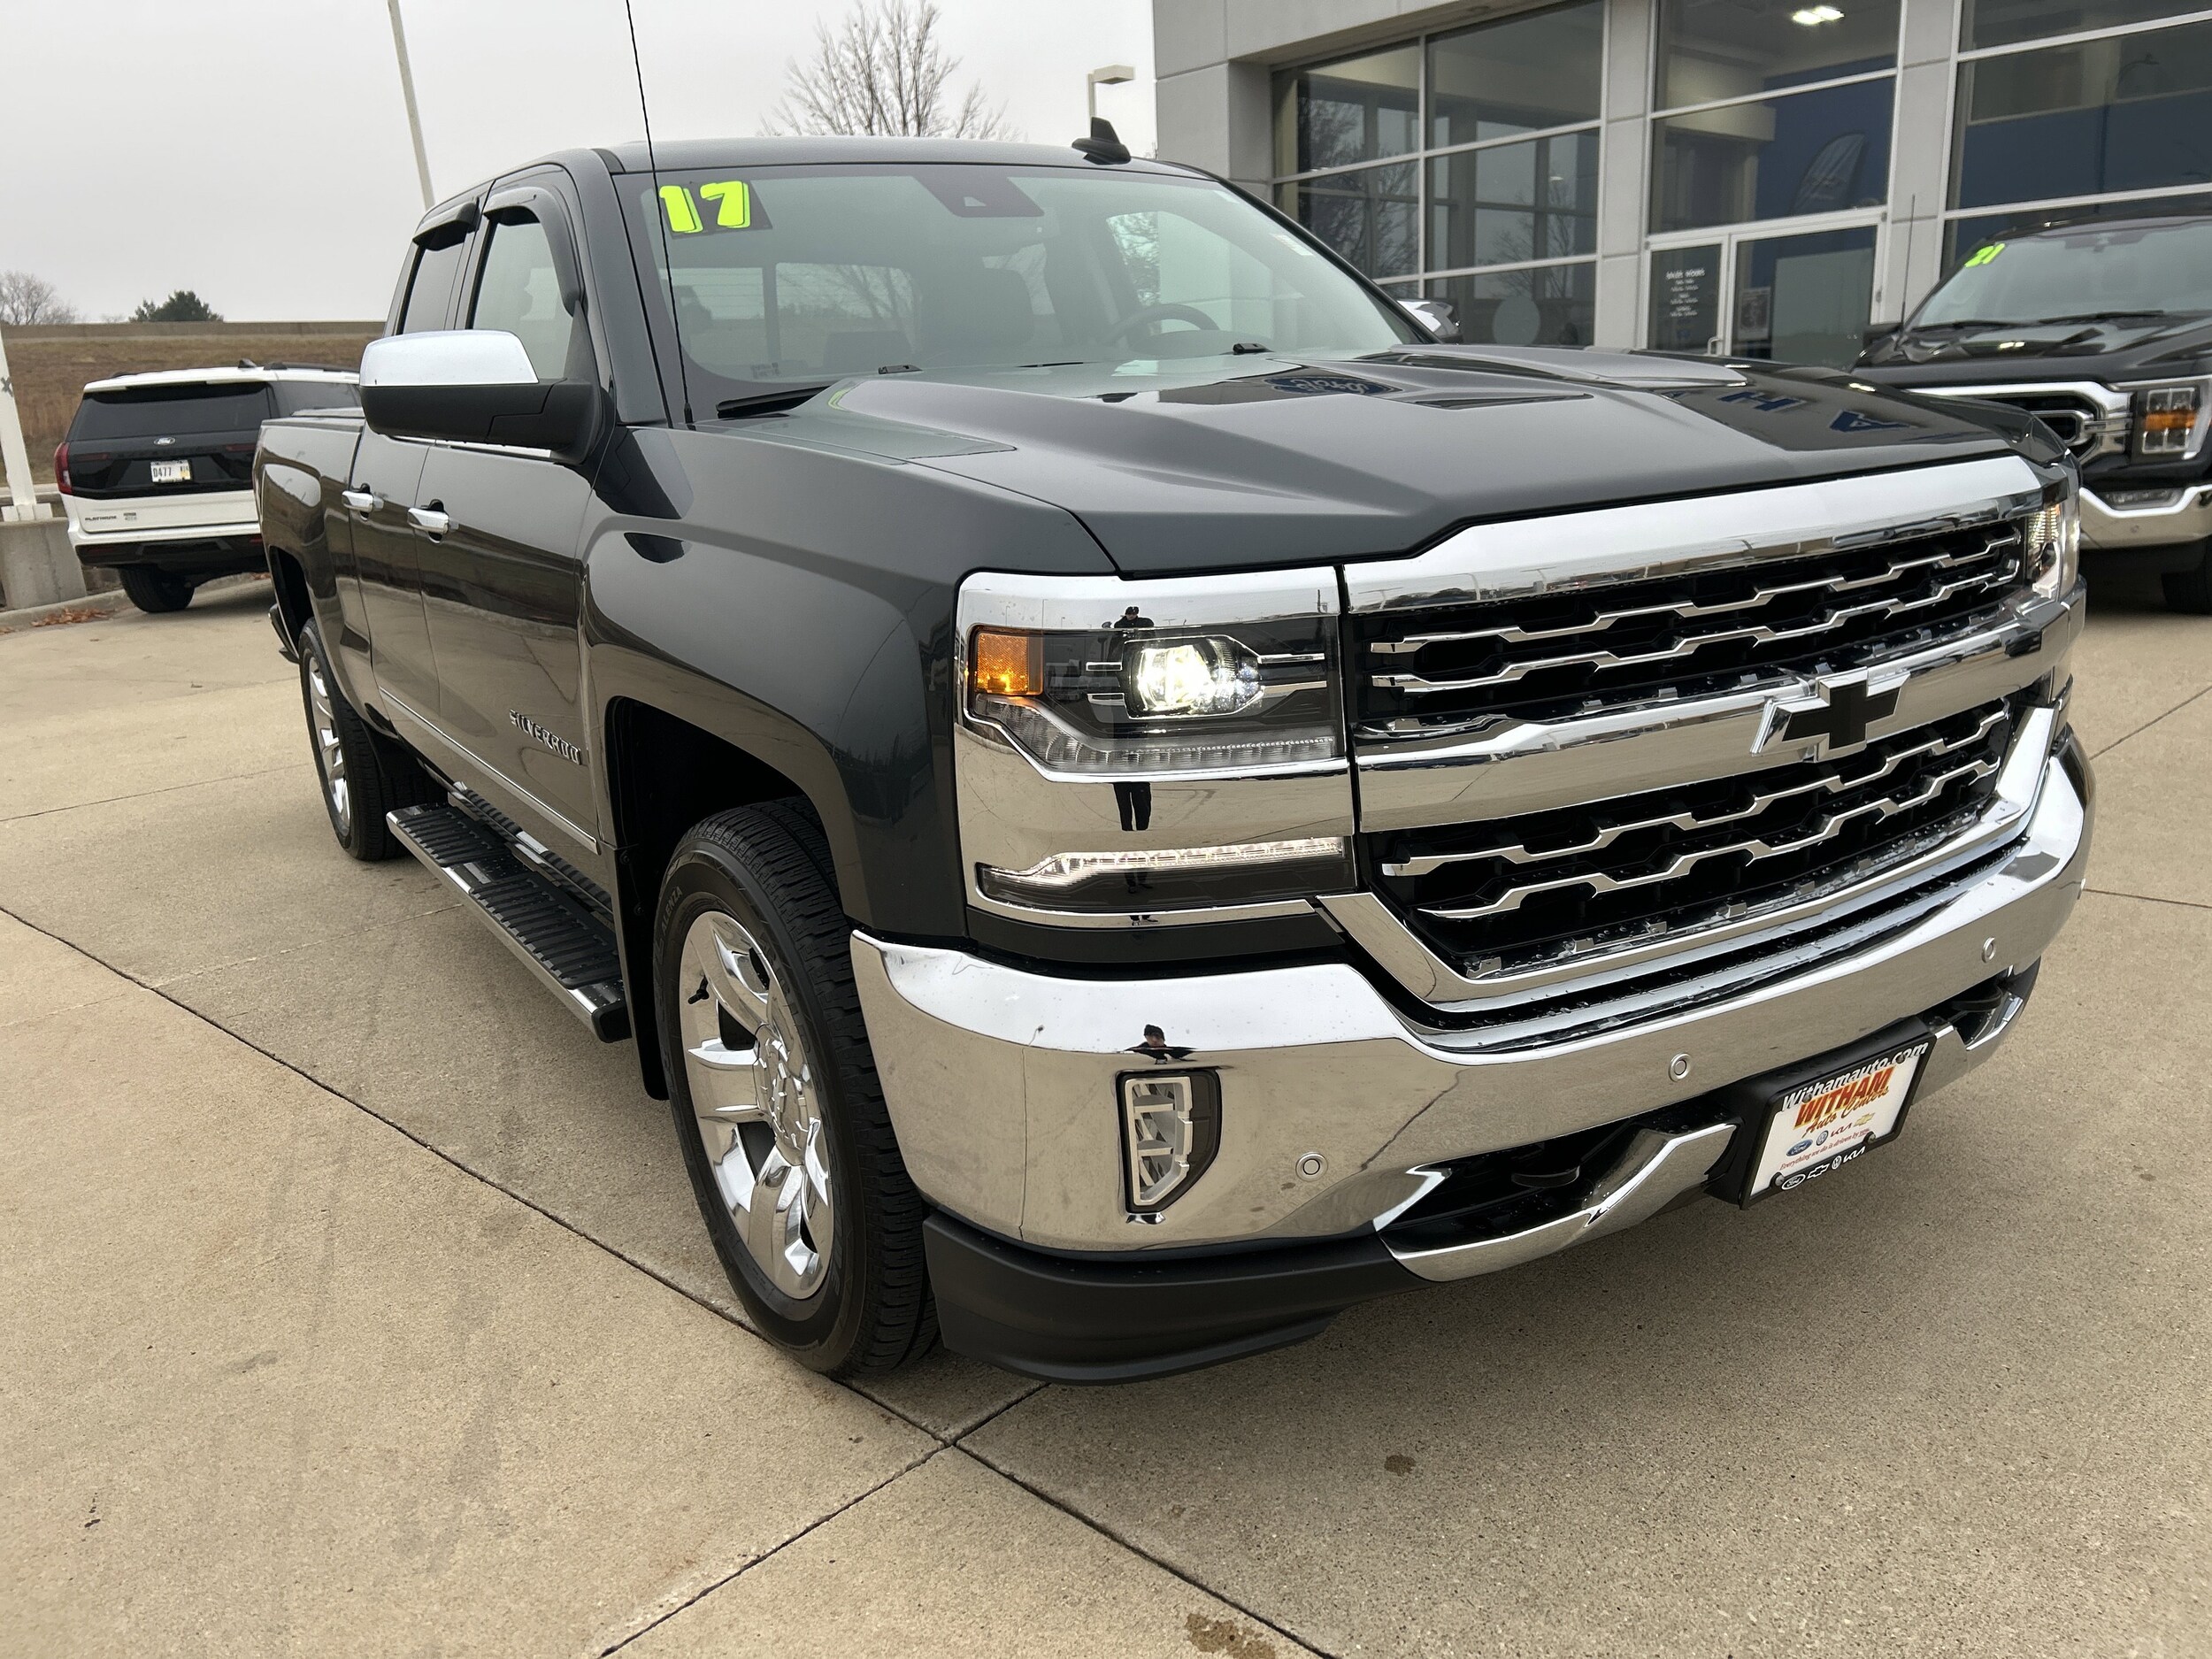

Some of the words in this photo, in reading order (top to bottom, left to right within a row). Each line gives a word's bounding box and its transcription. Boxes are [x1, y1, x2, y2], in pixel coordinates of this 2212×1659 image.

[659, 180, 751, 234] 17
[1963, 242, 2006, 268] 21
[509, 709, 582, 765] SILVERADO
[661, 886, 683, 937] ALENZA
[1794, 1065, 1895, 1129] WITHAM
[1801, 1112, 1838, 1139] Auto
[1840, 1086, 1889, 1118] Centers
